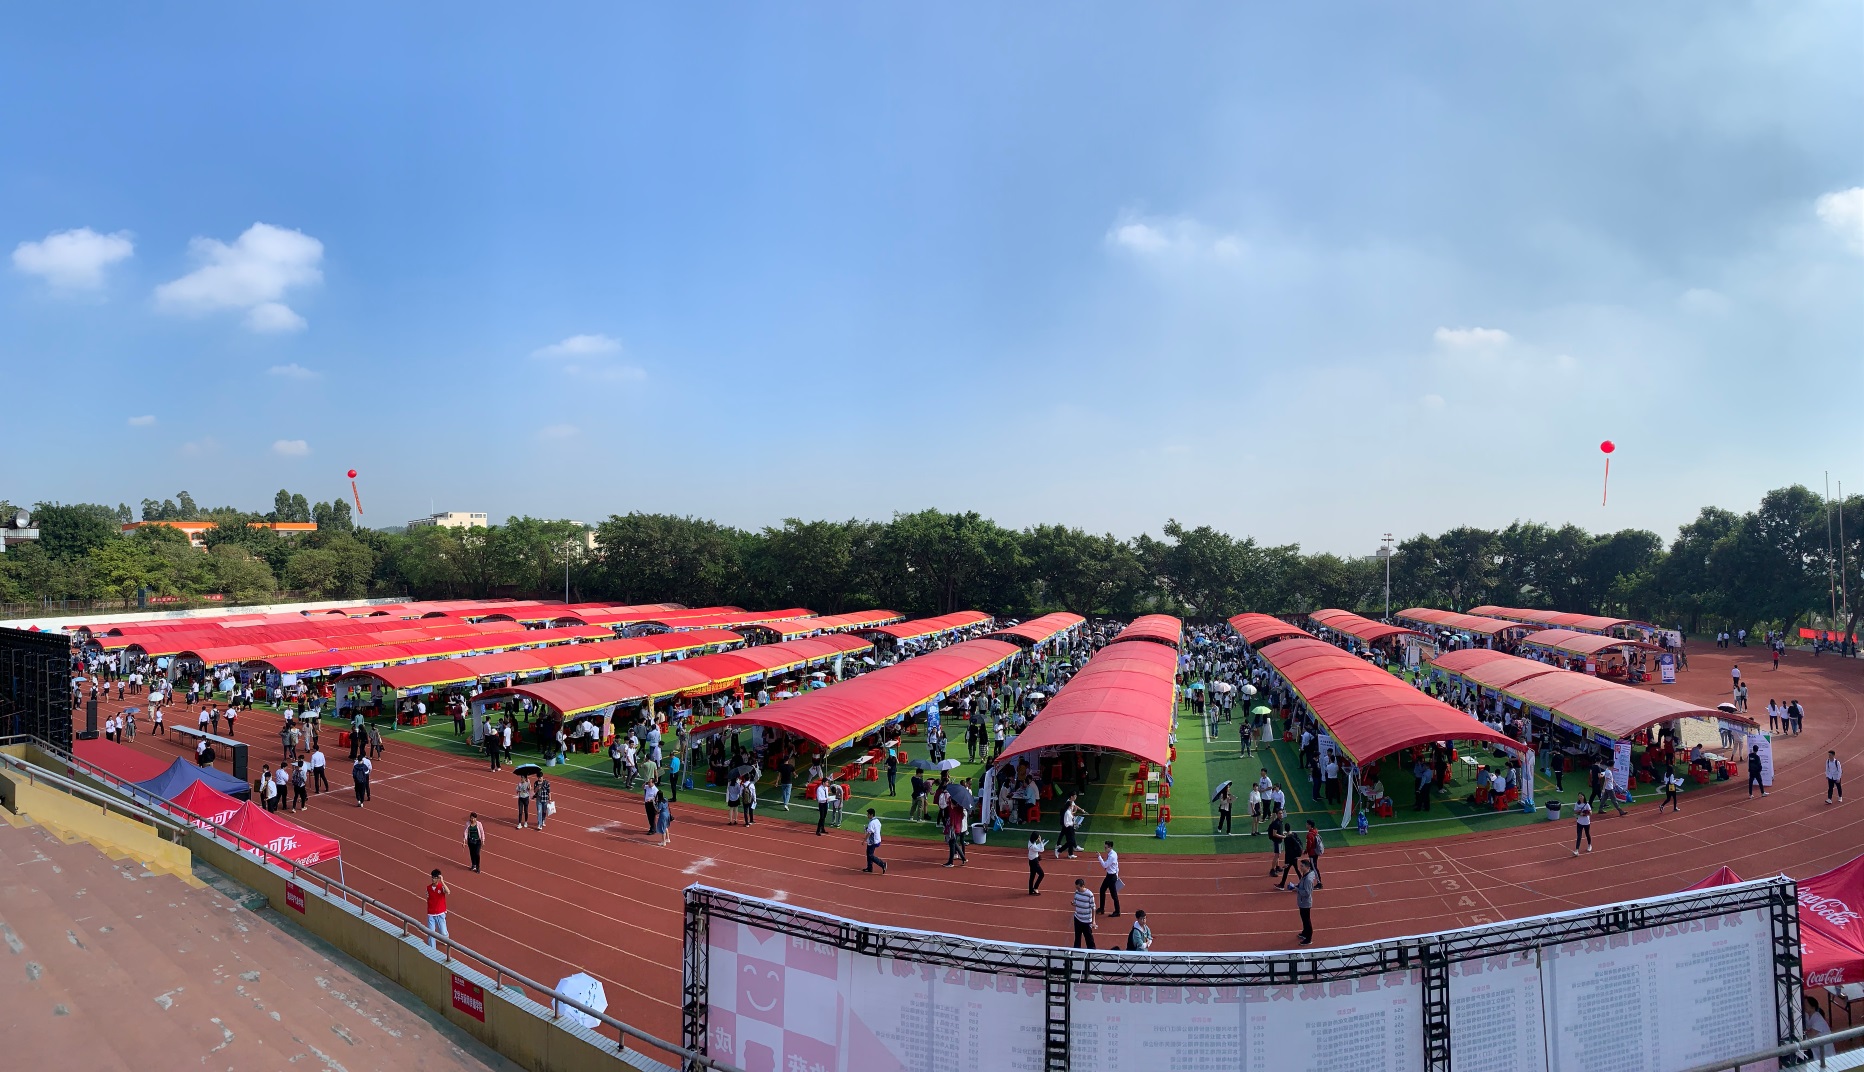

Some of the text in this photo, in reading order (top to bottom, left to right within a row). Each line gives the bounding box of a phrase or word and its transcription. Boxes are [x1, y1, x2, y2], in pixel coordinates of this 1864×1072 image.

[1418, 851, 1433, 860] 1
[1428, 864, 1449, 875] 2
[1441, 879, 1461, 890] 3
[1458, 895, 1477, 907] 4
